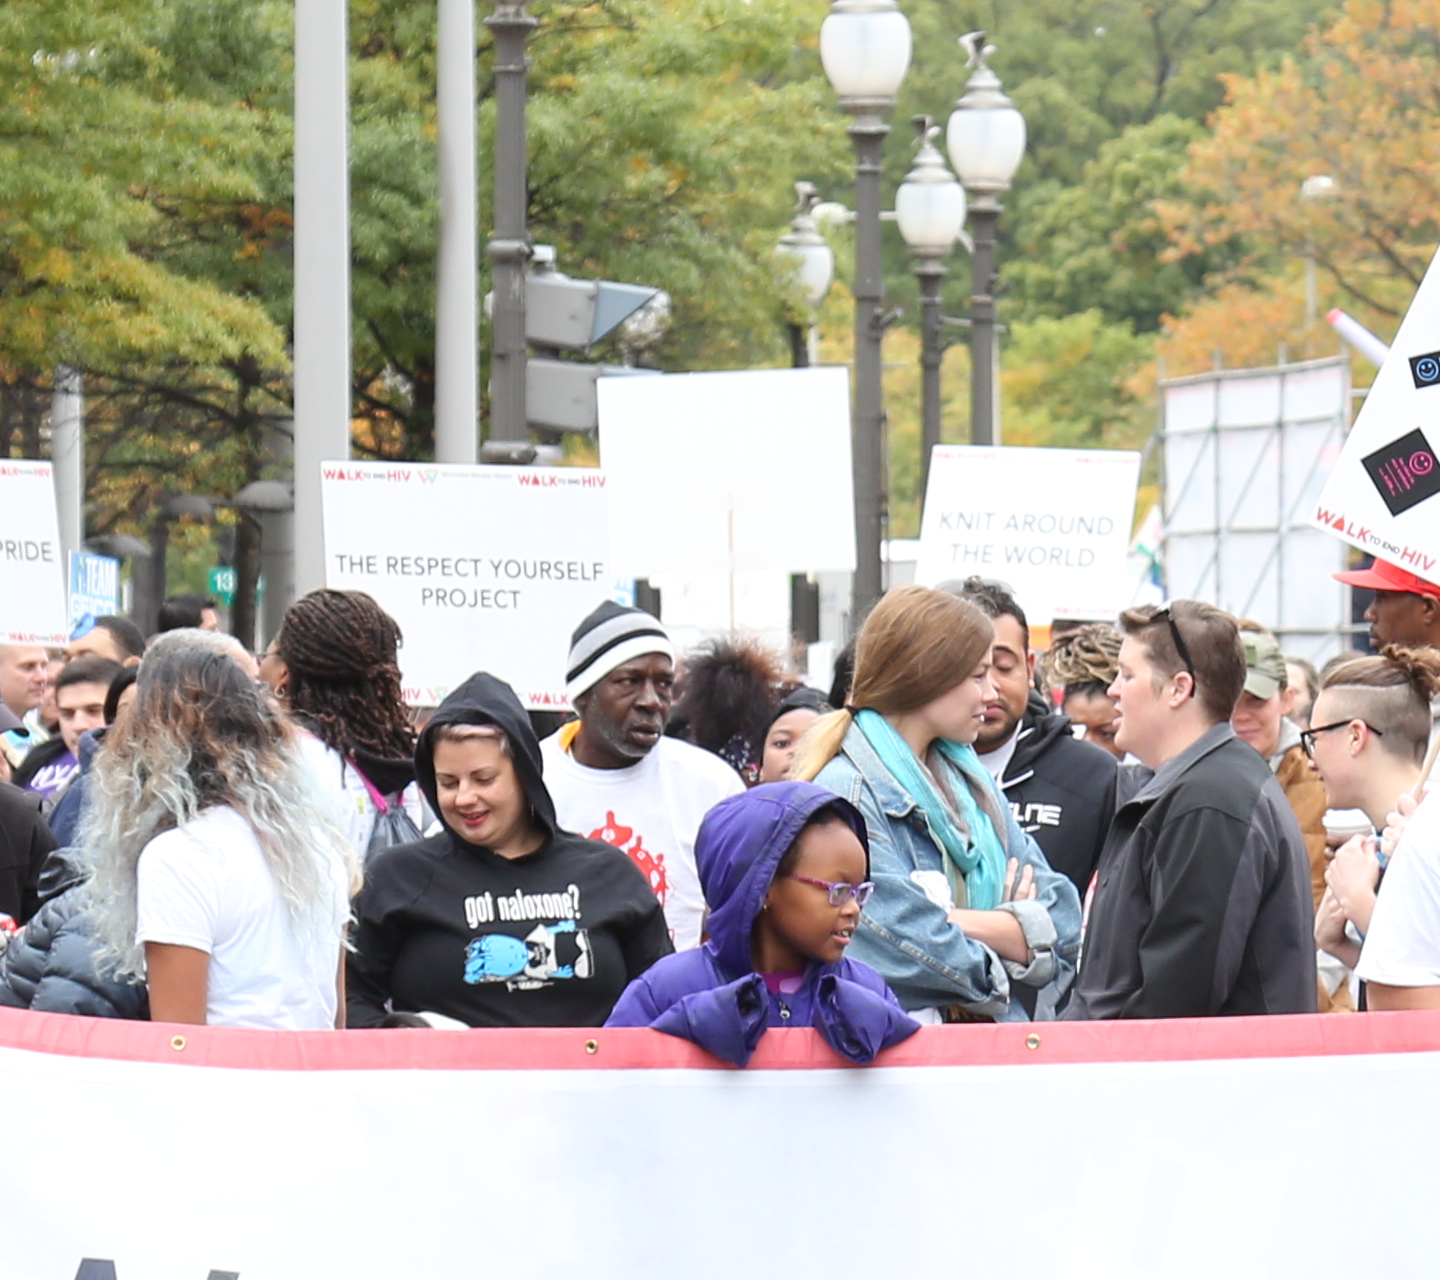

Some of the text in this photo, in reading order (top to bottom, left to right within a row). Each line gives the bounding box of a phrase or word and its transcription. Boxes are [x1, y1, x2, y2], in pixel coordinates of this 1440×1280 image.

[387, 471, 411, 482] HIV
[582, 476, 607, 488] HIV
[939, 511, 1114, 536] KNIT AROUND
[335, 554, 604, 581] THE RESPECT YOURSELF
[950, 543, 1095, 567] THE WORLD
[1400, 546, 1437, 571] HIV
[86, 558, 118, 598] TEAM
[421, 588, 521, 609] PROJECT
[464, 883, 582, 929] got naloxone?
